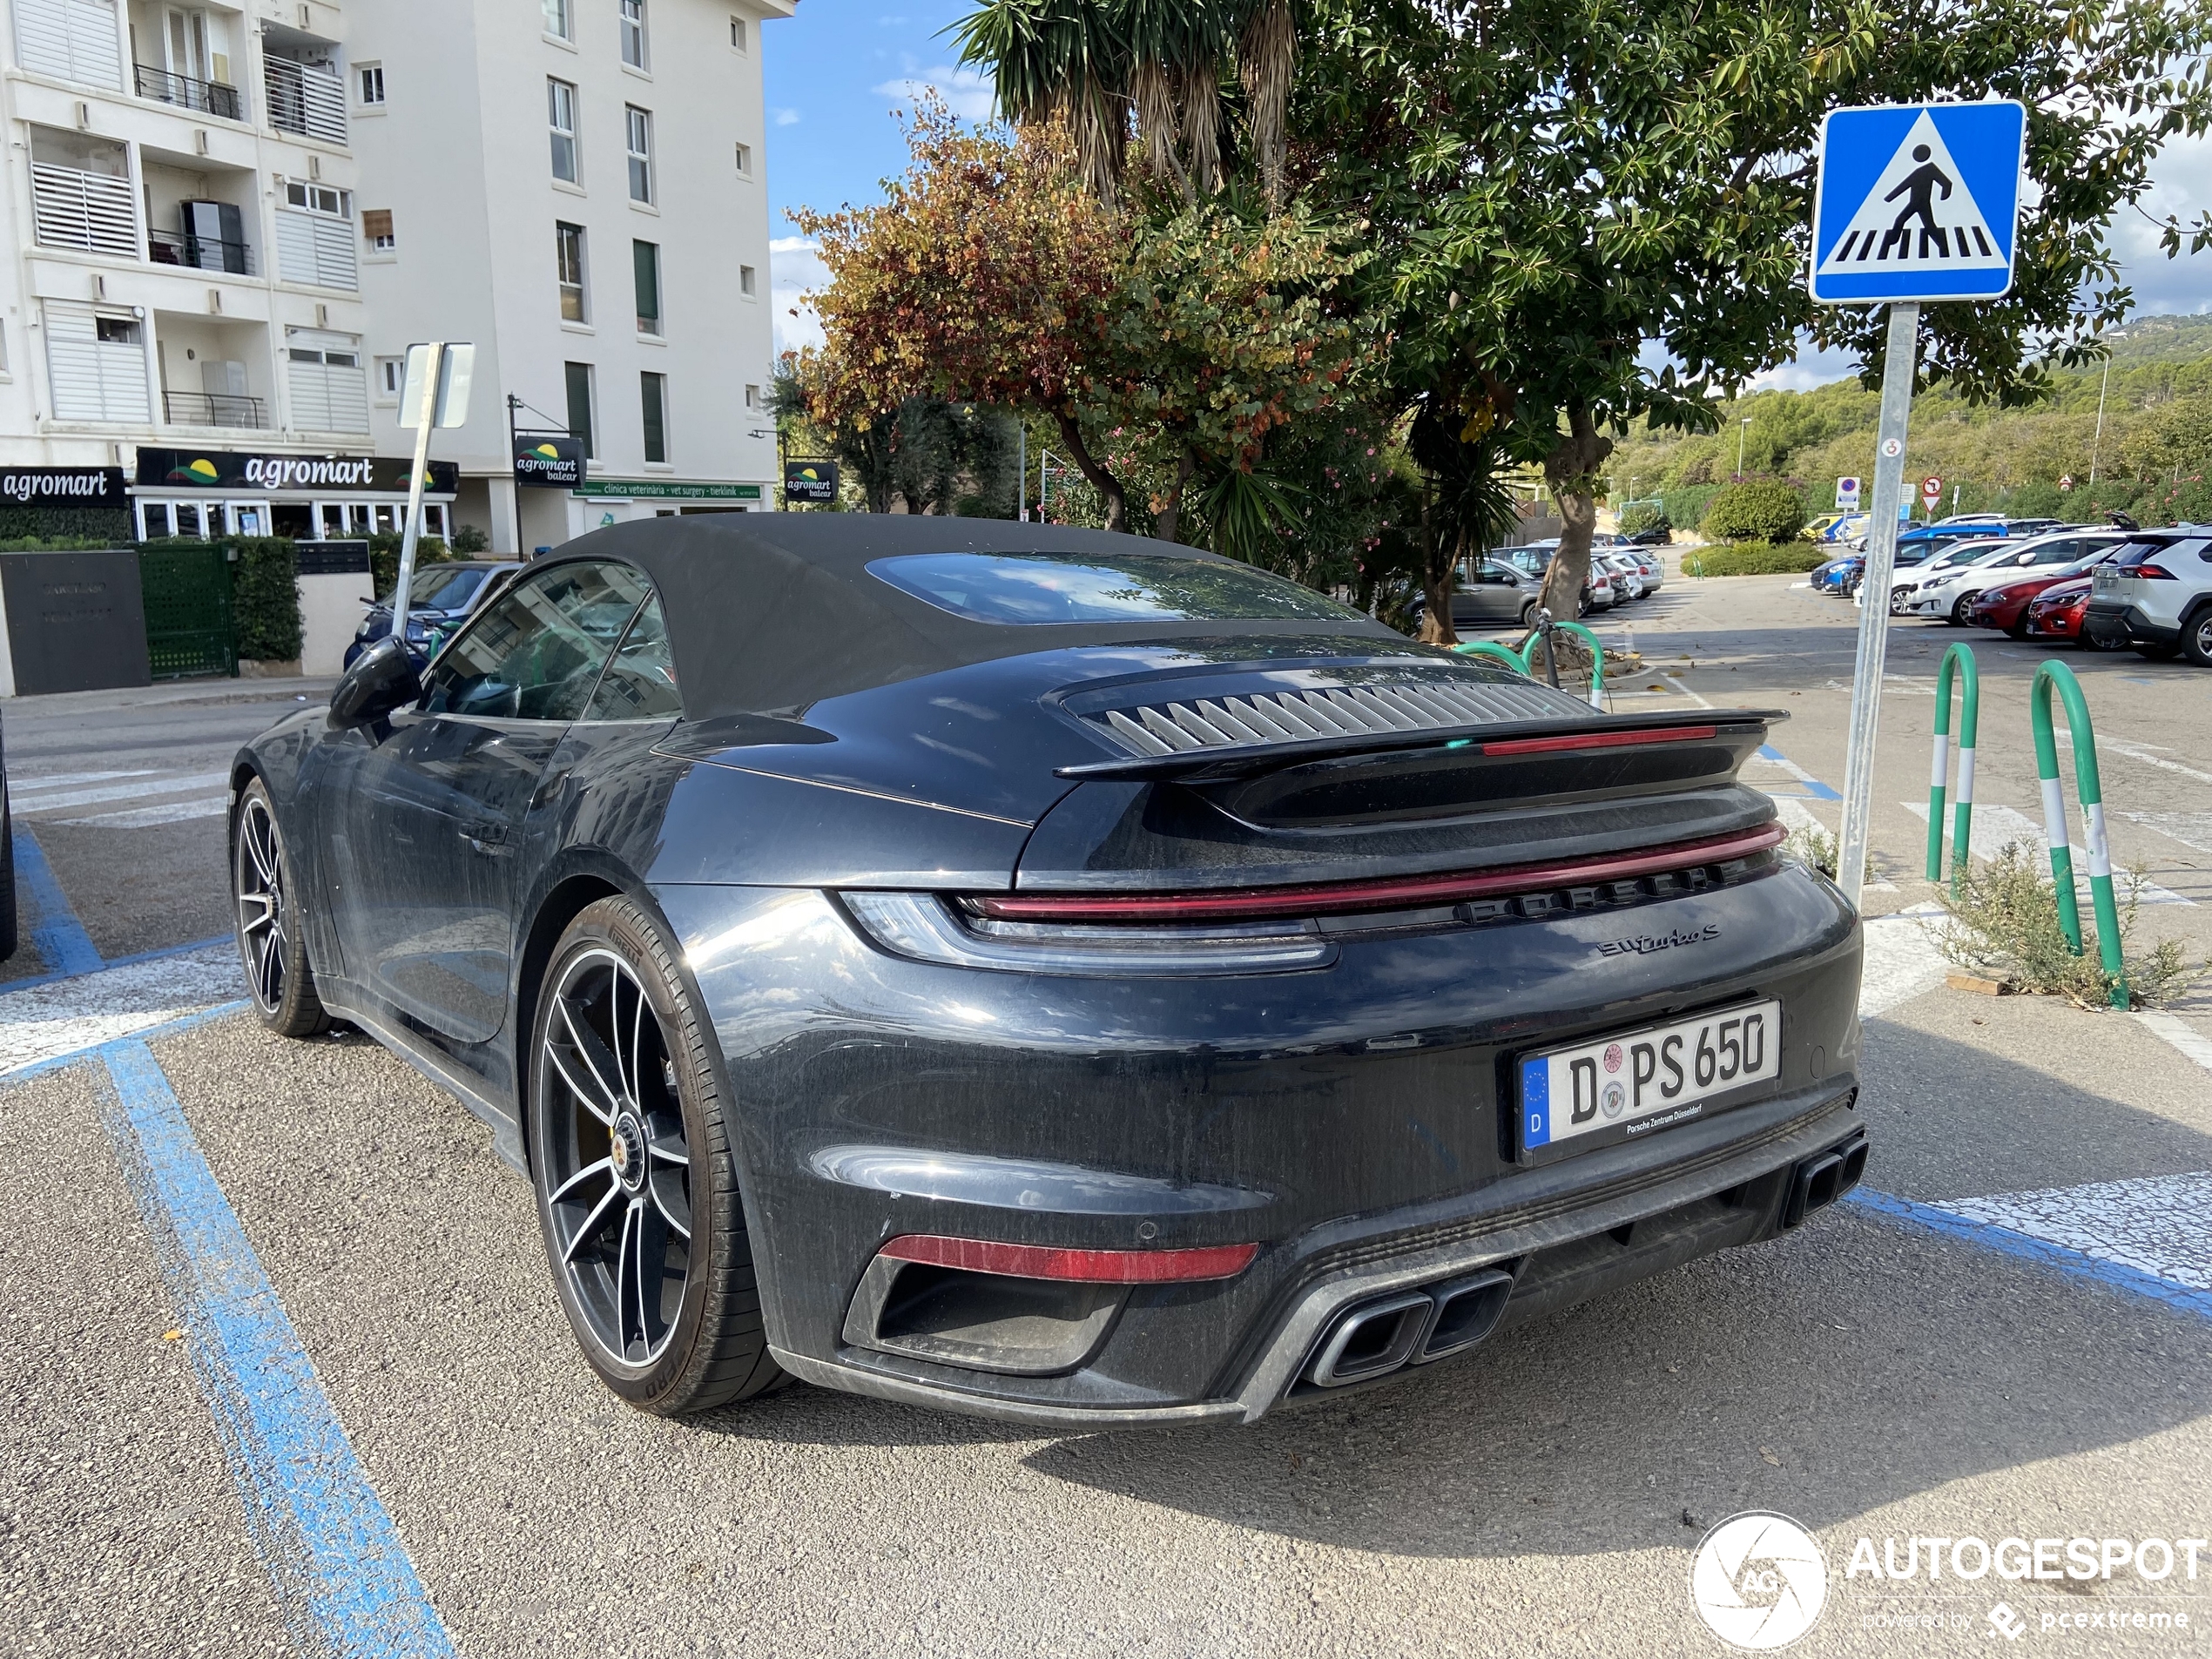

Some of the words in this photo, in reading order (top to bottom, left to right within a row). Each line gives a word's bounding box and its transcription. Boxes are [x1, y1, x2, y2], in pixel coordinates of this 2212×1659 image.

[246, 458, 373, 489] agromart
[517, 459, 576, 472] agromart
[547, 471, 577, 481] balear
[3, 471, 107, 501] agromart
[604, 482, 627, 494] clínica
[671, 486, 681, 495] vet
[683, 487, 705, 497] surgery
[711, 486, 737, 496] tierklinik
[787, 481, 830, 491] agromart
[608, 923, 644, 968] PIRELLI
[1596, 936, 1638, 957] 911
[1636, 928, 1701, 955] turbo
[1703, 922, 1723, 941] S
[1569, 1056, 1597, 1125] D
[1630, 1035, 1684, 1108] PS
[1695, 1013, 1764, 1088] 650
[1531, 1113, 1541, 1133] D
[1627, 1121, 1650, 1135] Porsche
[1649, 1115, 1673, 1128] Zentrum
[1674, 1103, 1703, 1121] Düsseldorf
